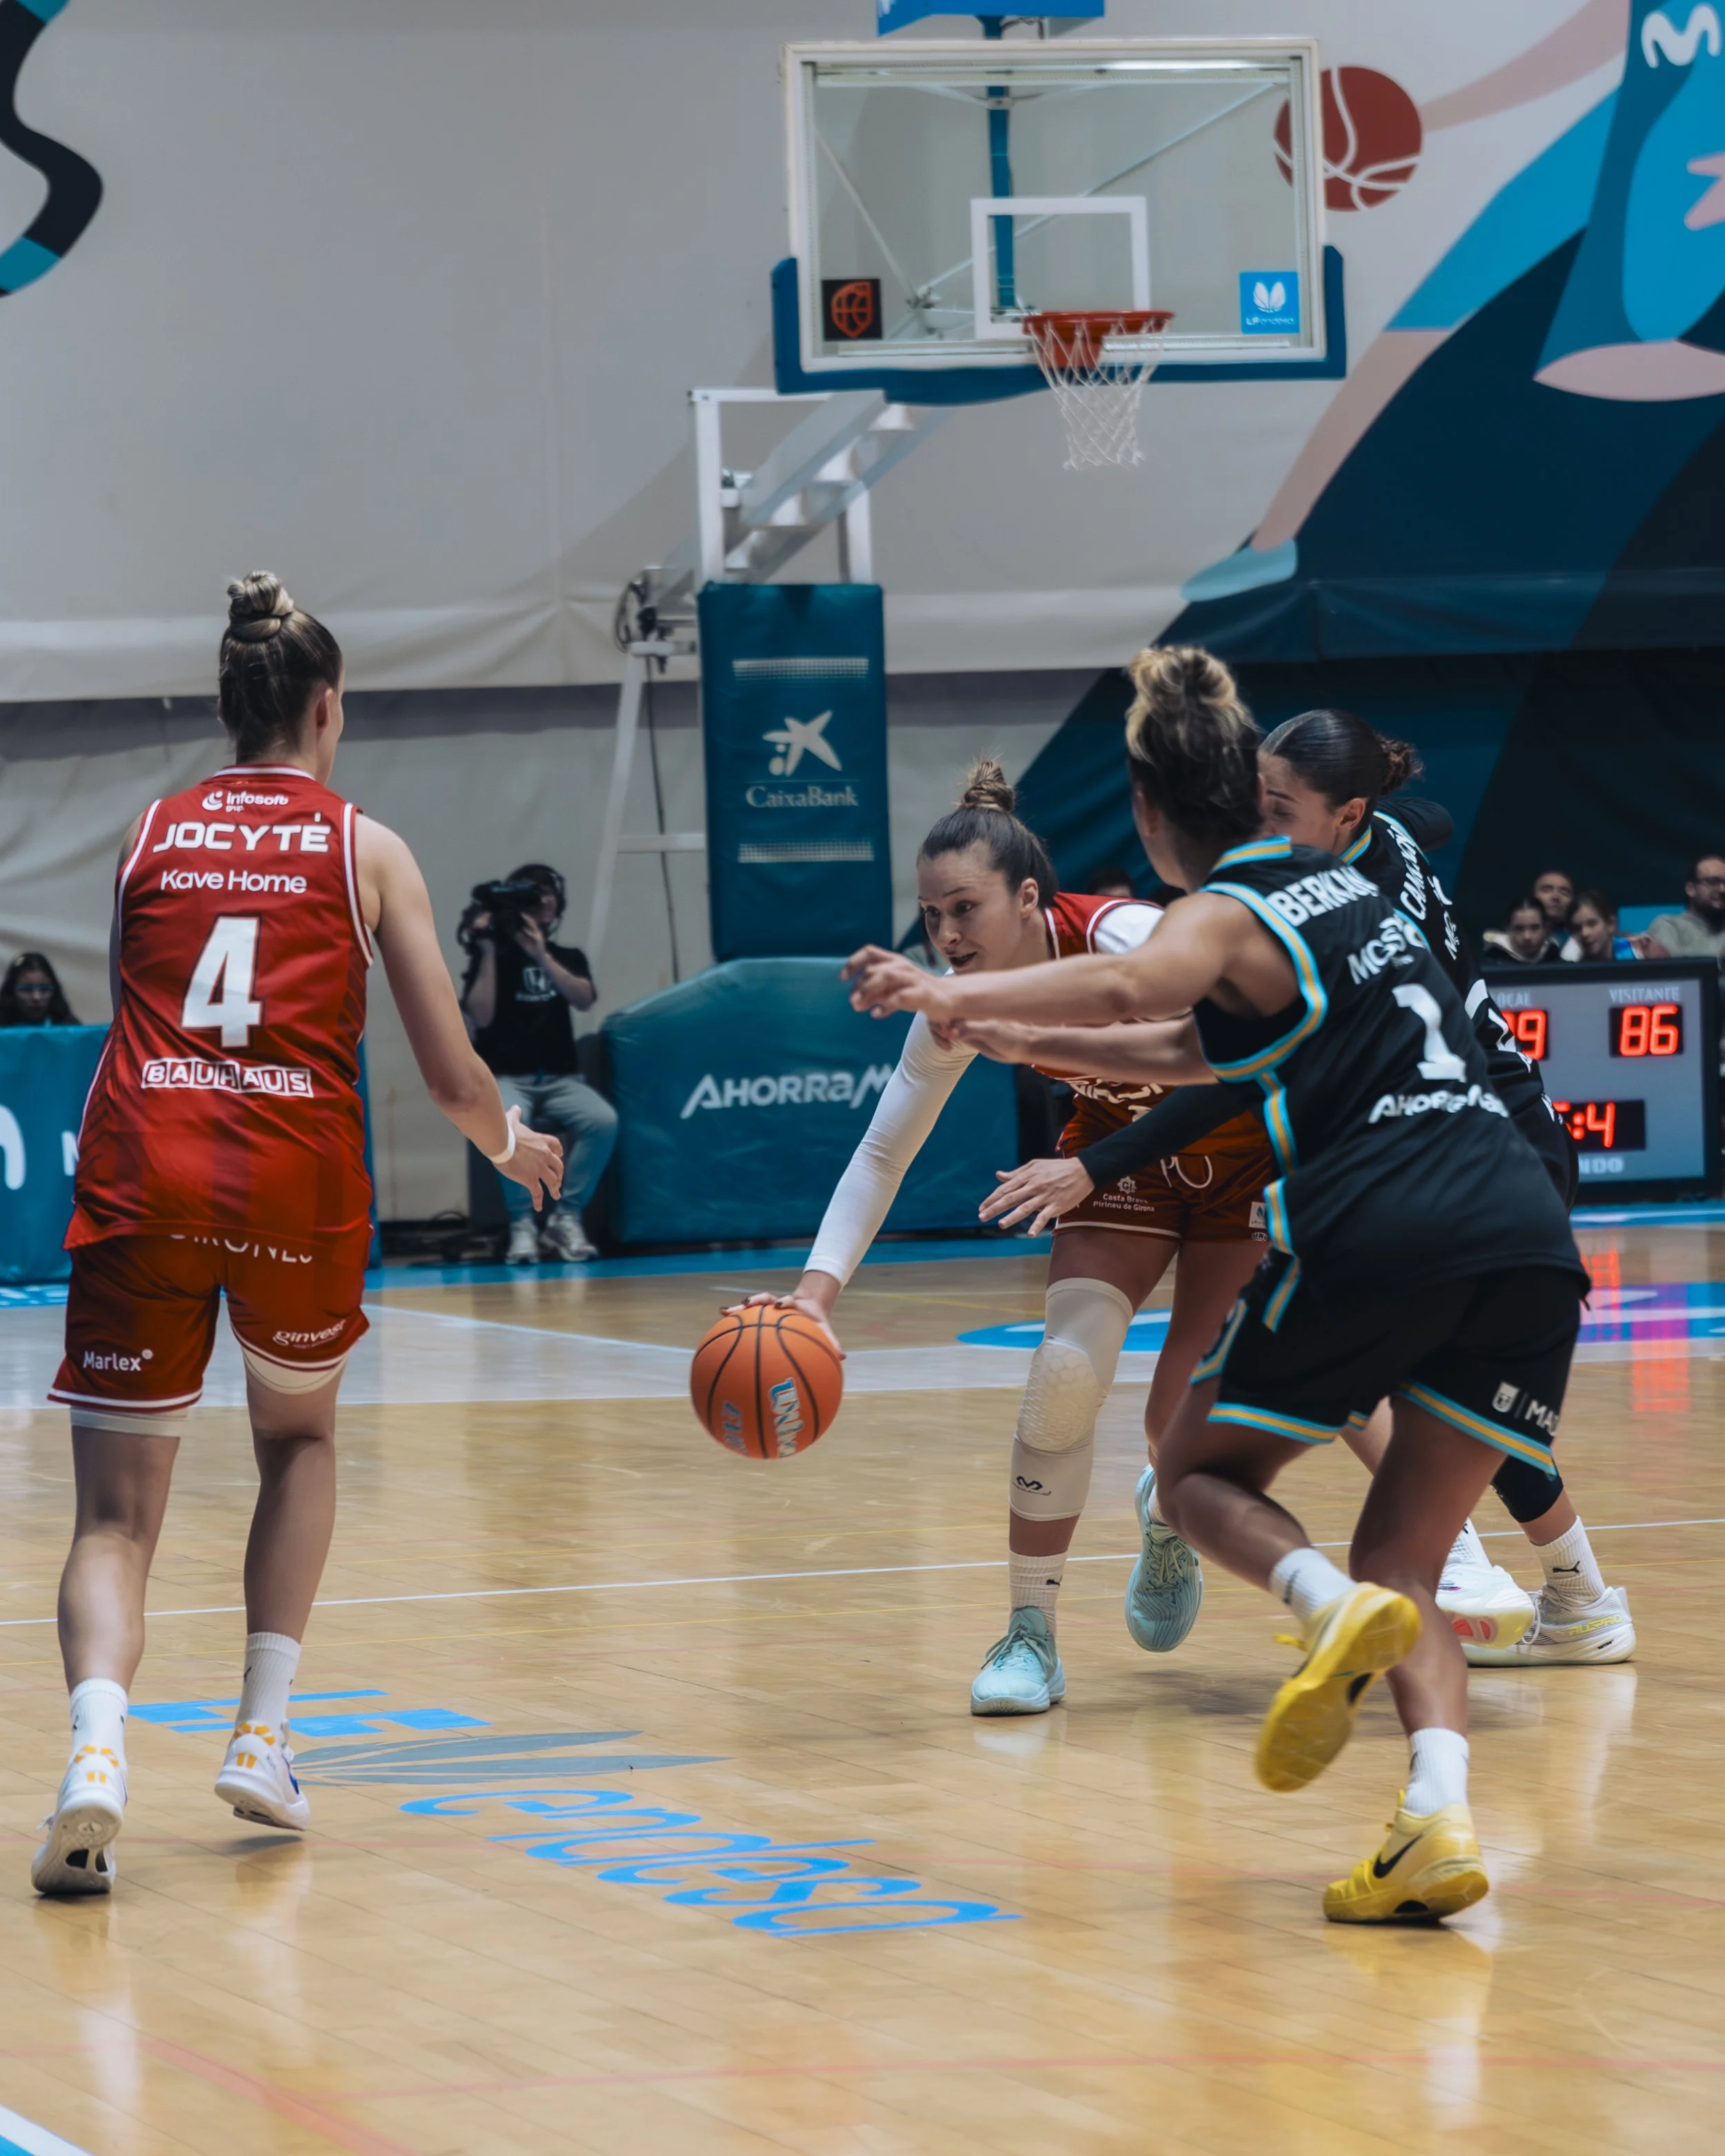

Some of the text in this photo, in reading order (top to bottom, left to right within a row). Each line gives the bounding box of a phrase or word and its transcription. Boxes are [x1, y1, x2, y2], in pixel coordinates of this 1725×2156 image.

[745, 785, 858, 808] CaixaBank
[160, 869, 308, 894] Kave Home
[181, 916, 263, 1048] 4
[1496, 991, 1532, 1007] OCAL
[1608, 987, 1680, 1002] VISITANTE
[1392, 983, 1467, 1082] 1
[1501, 1009, 1547, 1060] 9
[1619, 1005, 1679, 1057] 86
[144, 1062, 310, 1095] BAUHAUS
[1093, 1200, 1122, 1209] Pirineu
[1134, 1204, 1155, 1212] Girona
[1103, 1193, 1125, 1202] Costa
[83, 1350, 142, 1372] Marlex
